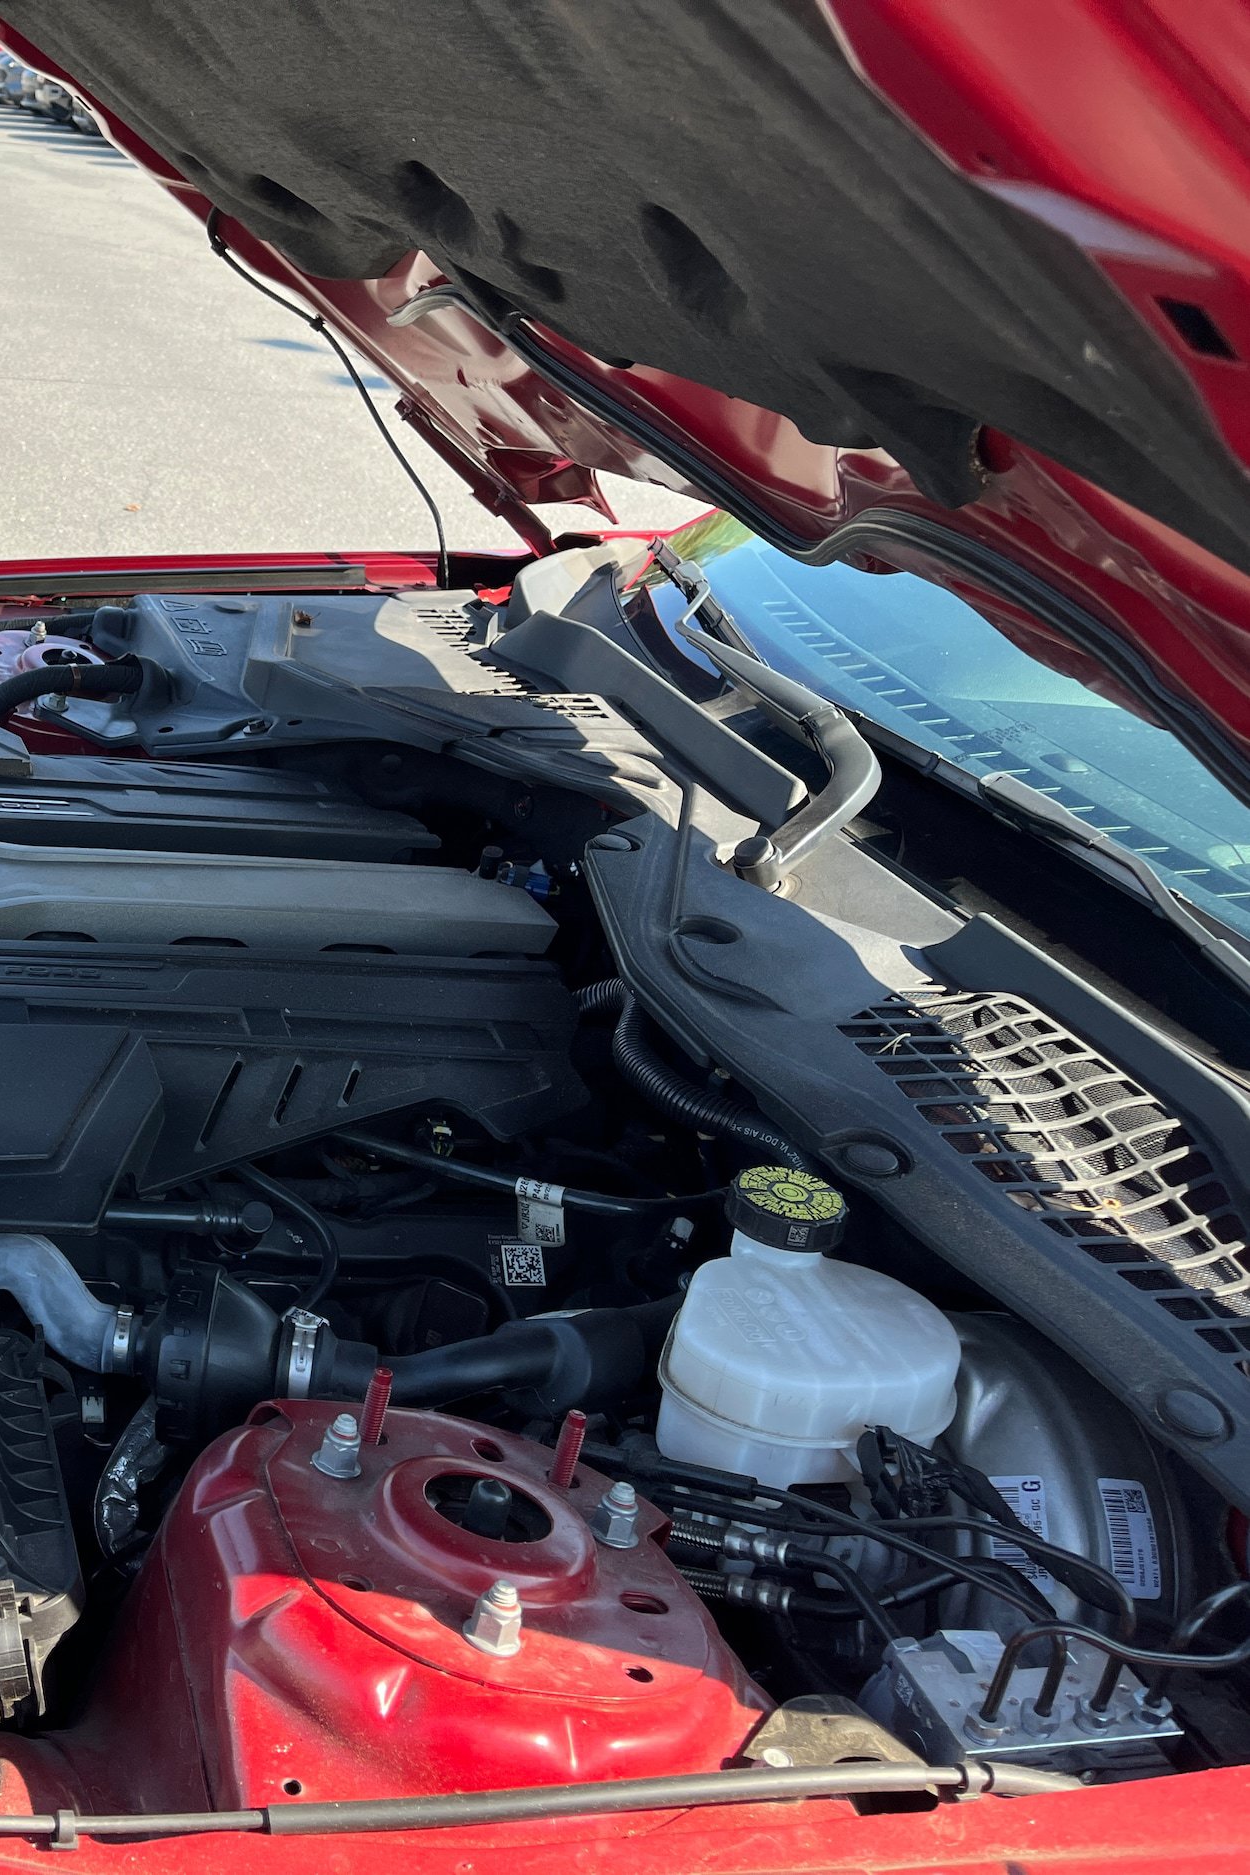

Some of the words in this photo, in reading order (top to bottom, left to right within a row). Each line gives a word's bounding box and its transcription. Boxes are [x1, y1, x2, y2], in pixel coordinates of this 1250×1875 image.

[5, 965, 101, 978] FORD
[759, 1133, 779, 1147] DOT
[1021, 1480, 1041, 1492] G
